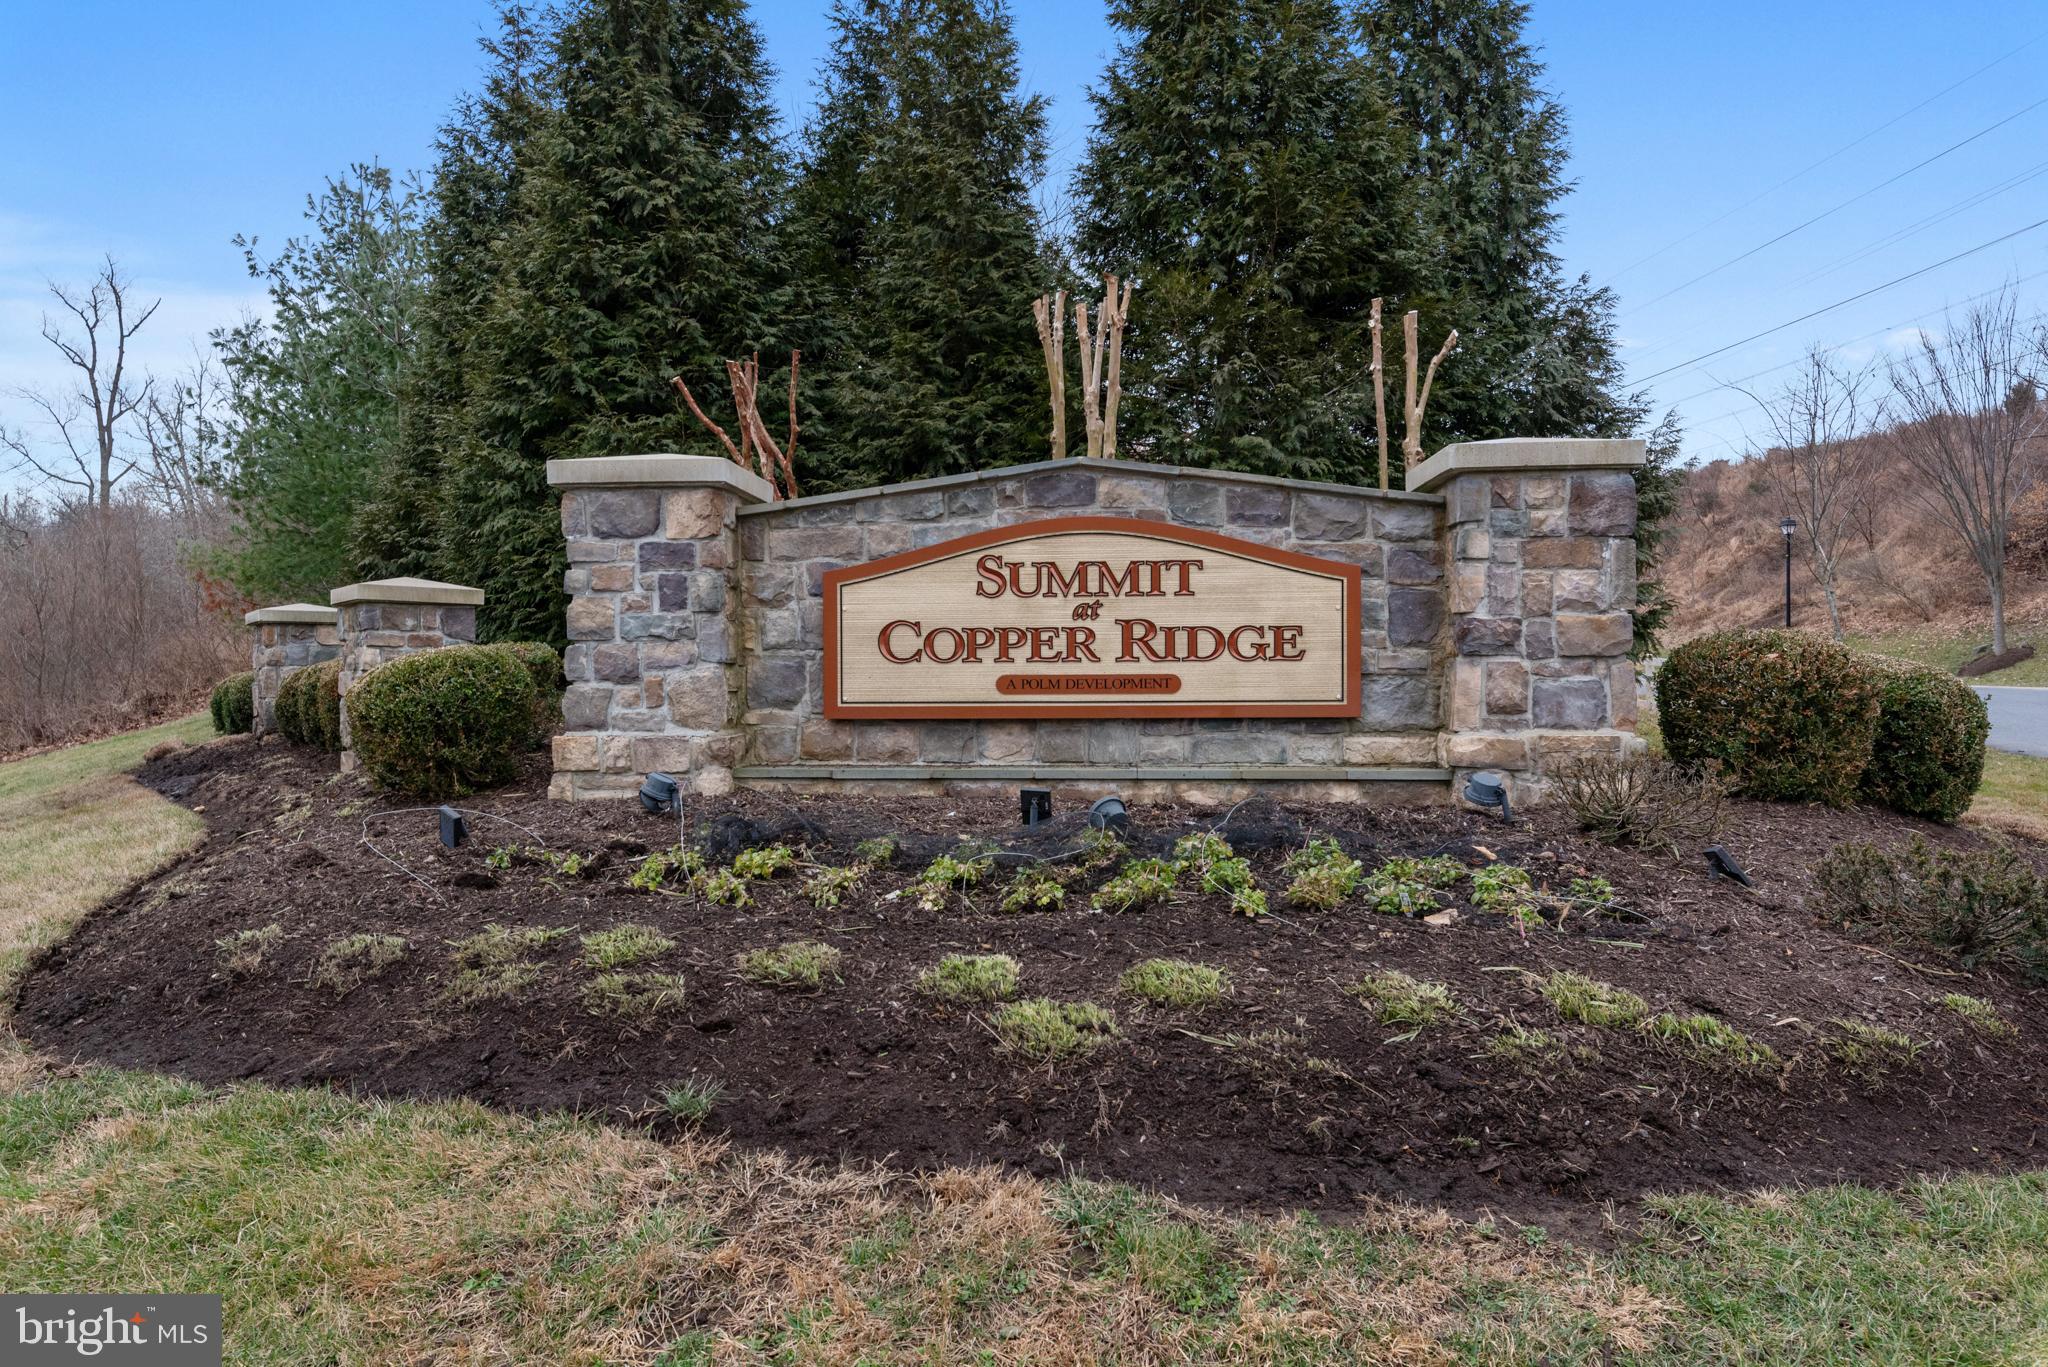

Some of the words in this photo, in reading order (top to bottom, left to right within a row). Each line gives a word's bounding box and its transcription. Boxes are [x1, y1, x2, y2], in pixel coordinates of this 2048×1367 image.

[975, 554, 1203, 598] SUMMIT
[1071, 599, 1104, 621] at
[877, 619, 1101, 664] COPPER
[1115, 618, 1306, 663] RIDGE
[1006, 678, 1016, 690] A
[1021, 678, 1061, 690] POLM
[1065, 677, 1172, 690] DEVELOPMENT
